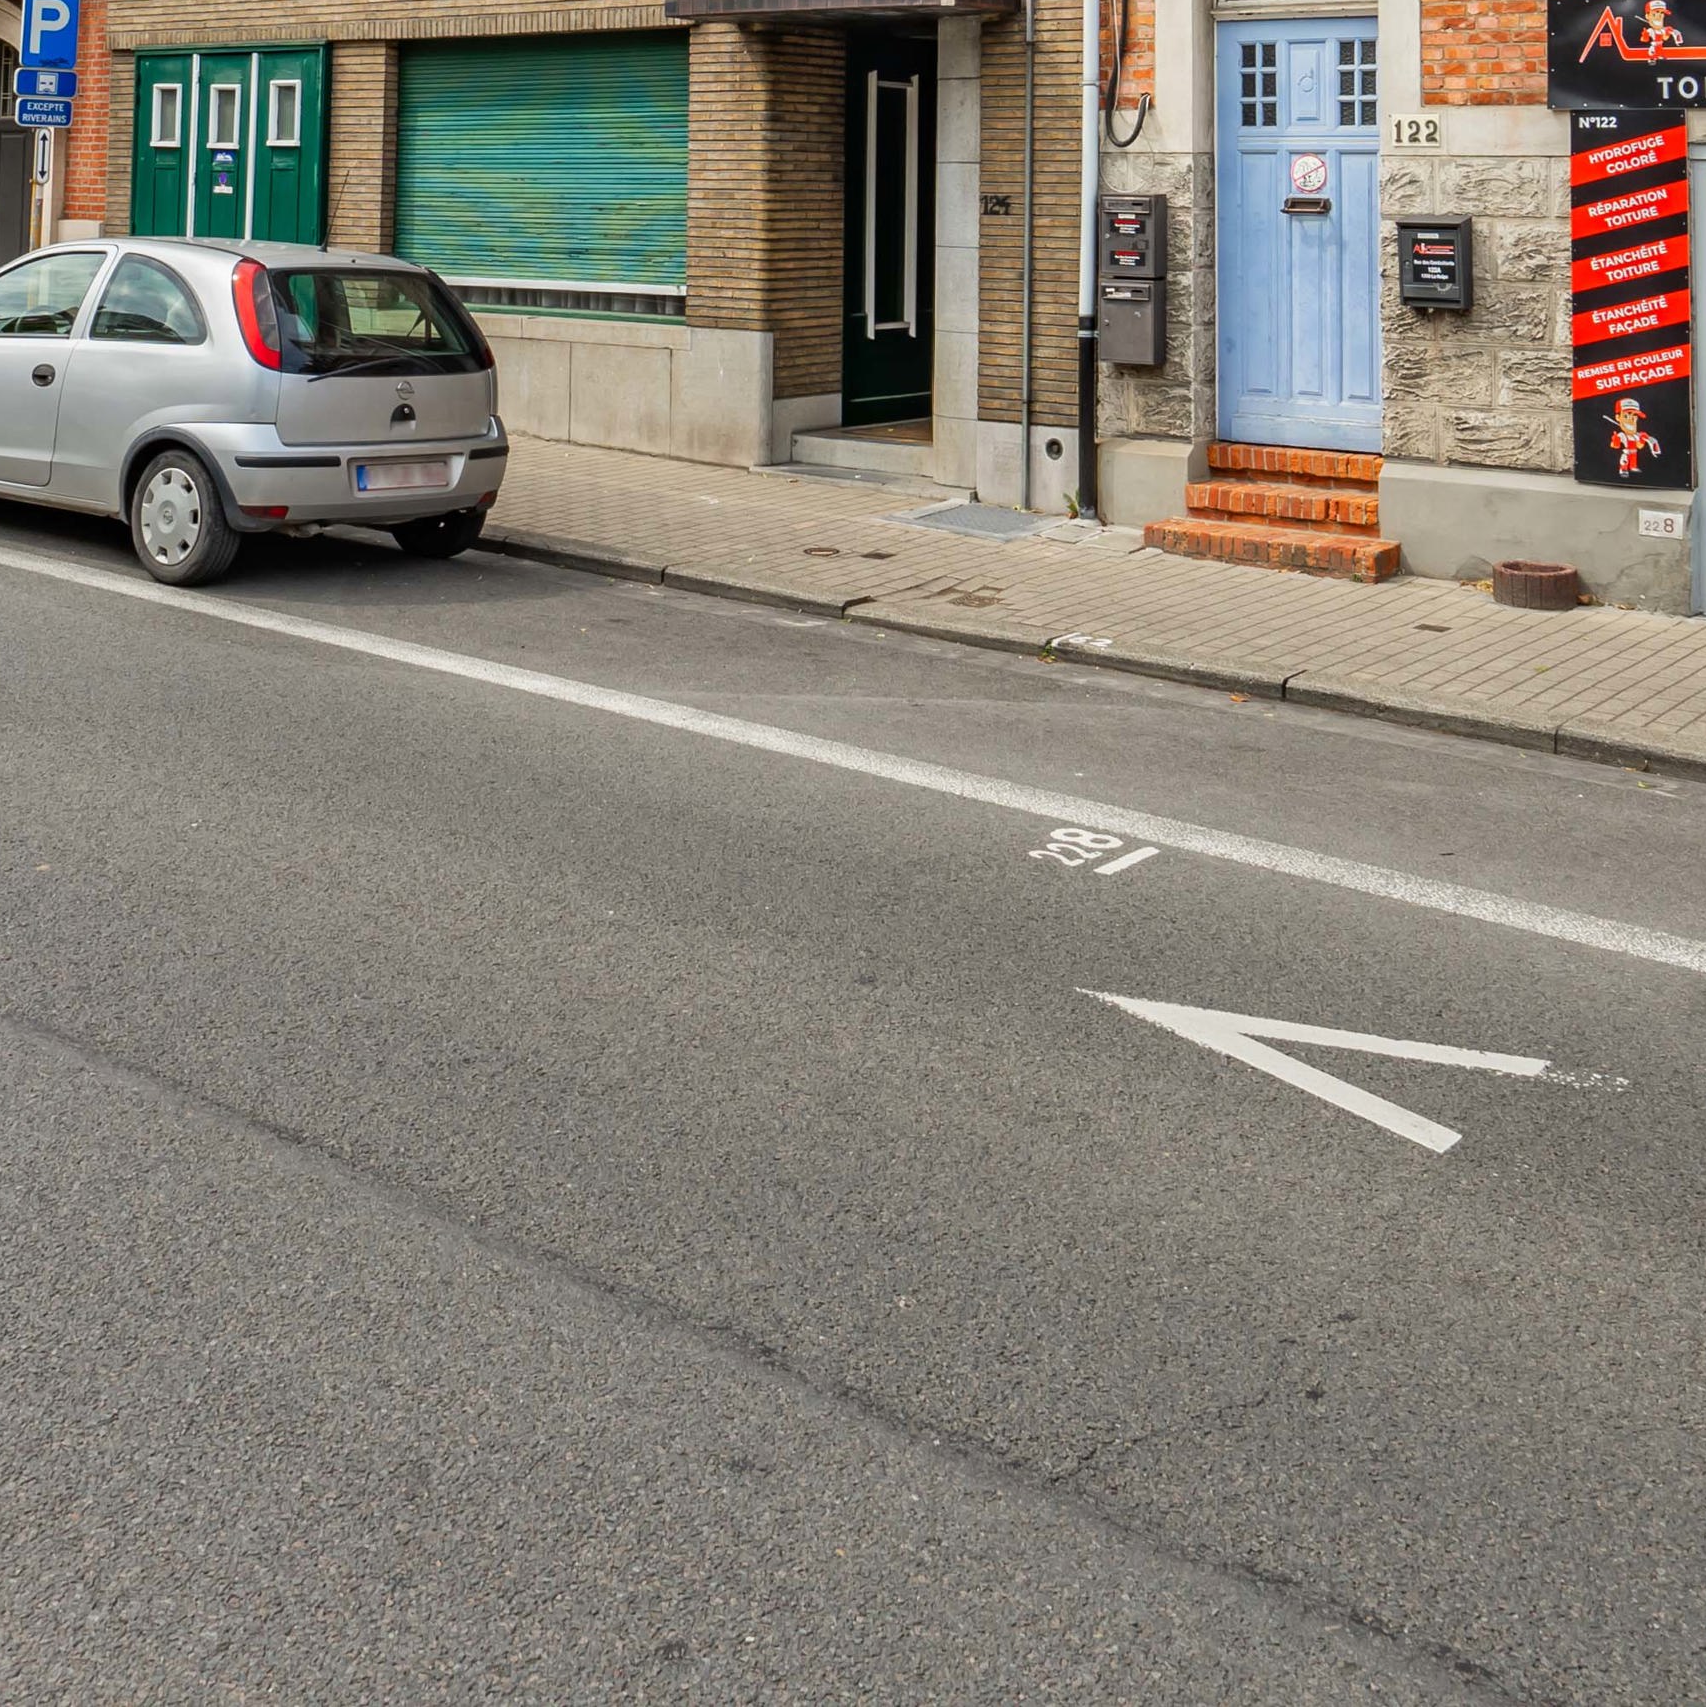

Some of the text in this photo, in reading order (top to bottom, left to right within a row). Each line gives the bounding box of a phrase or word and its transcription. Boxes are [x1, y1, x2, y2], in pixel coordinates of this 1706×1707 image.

[27, 101, 64, 112] EXCEPTE
[22, 114, 67, 124] RIVERAINS
[1394, 119, 1438, 143] 122
[1588, 135, 1665, 164] HYDROFUGE
[1606, 150, 1658, 174] COLORÉ
[1588, 189, 1668, 217] RÉPARATION
[1605, 206, 1659, 227] TOITURE
[1590, 241, 1668, 271] ÉTANCHÉITÉ
[1605, 261, 1660, 281] TOITURE
[1592, 295, 1668, 323] ÉTANCHÉITÉ
[1609, 315, 1659, 334] FAÇADE
[1577, 349, 1684, 379] REMISE EN COULEUR
[1596, 365, 1675, 390] SUR FAÇADE
